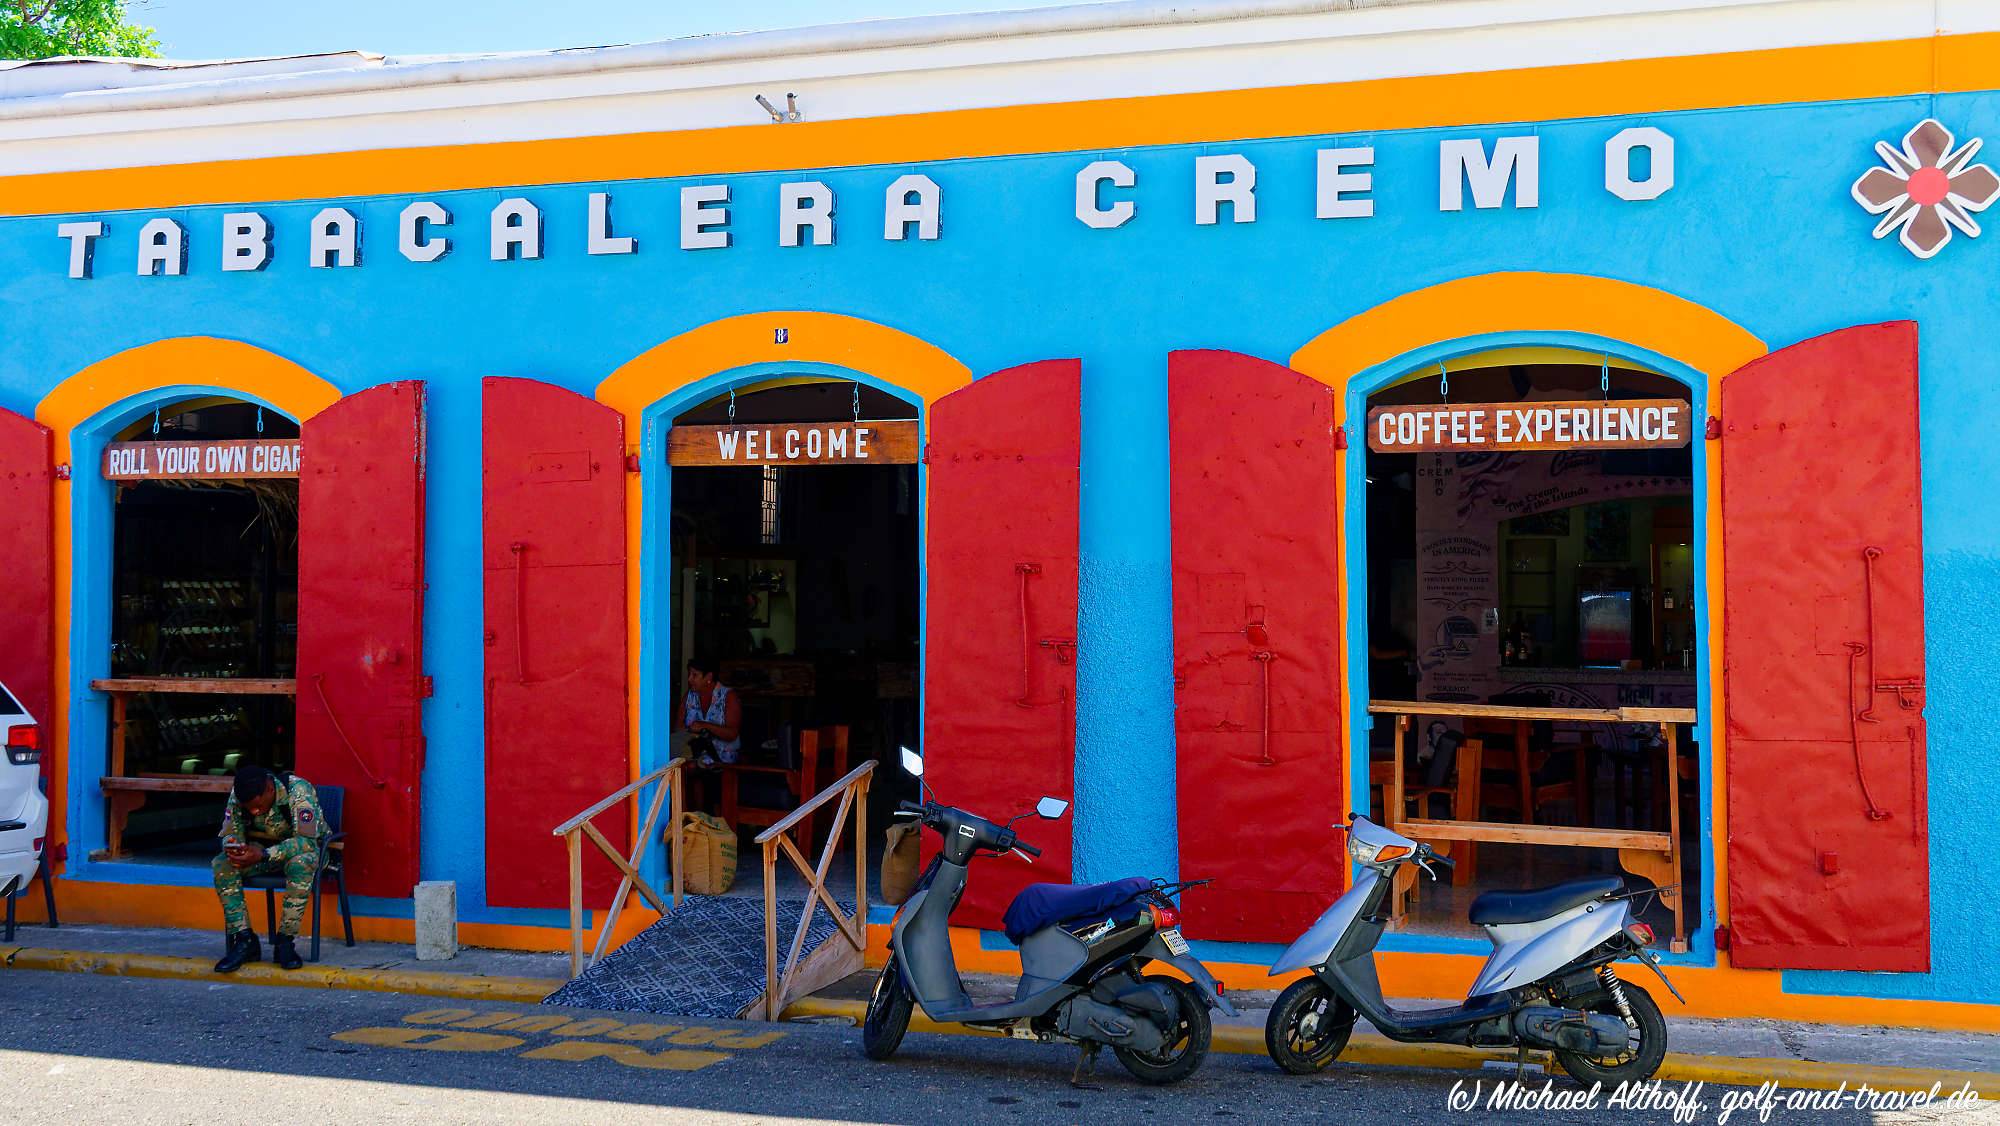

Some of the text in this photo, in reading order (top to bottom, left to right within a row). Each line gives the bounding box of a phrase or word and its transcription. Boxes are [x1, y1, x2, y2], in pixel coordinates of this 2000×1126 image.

[58, 127, 1675, 279] TABACALERA CREMO
[717, 428, 870, 460] WELCOME
[1378, 406, 1680, 446] COFFEE EXPERIENCE
[109, 448, 150, 476] ROLL
[156, 446, 200, 474] YOUR
[205, 446, 247, 474] OWN
